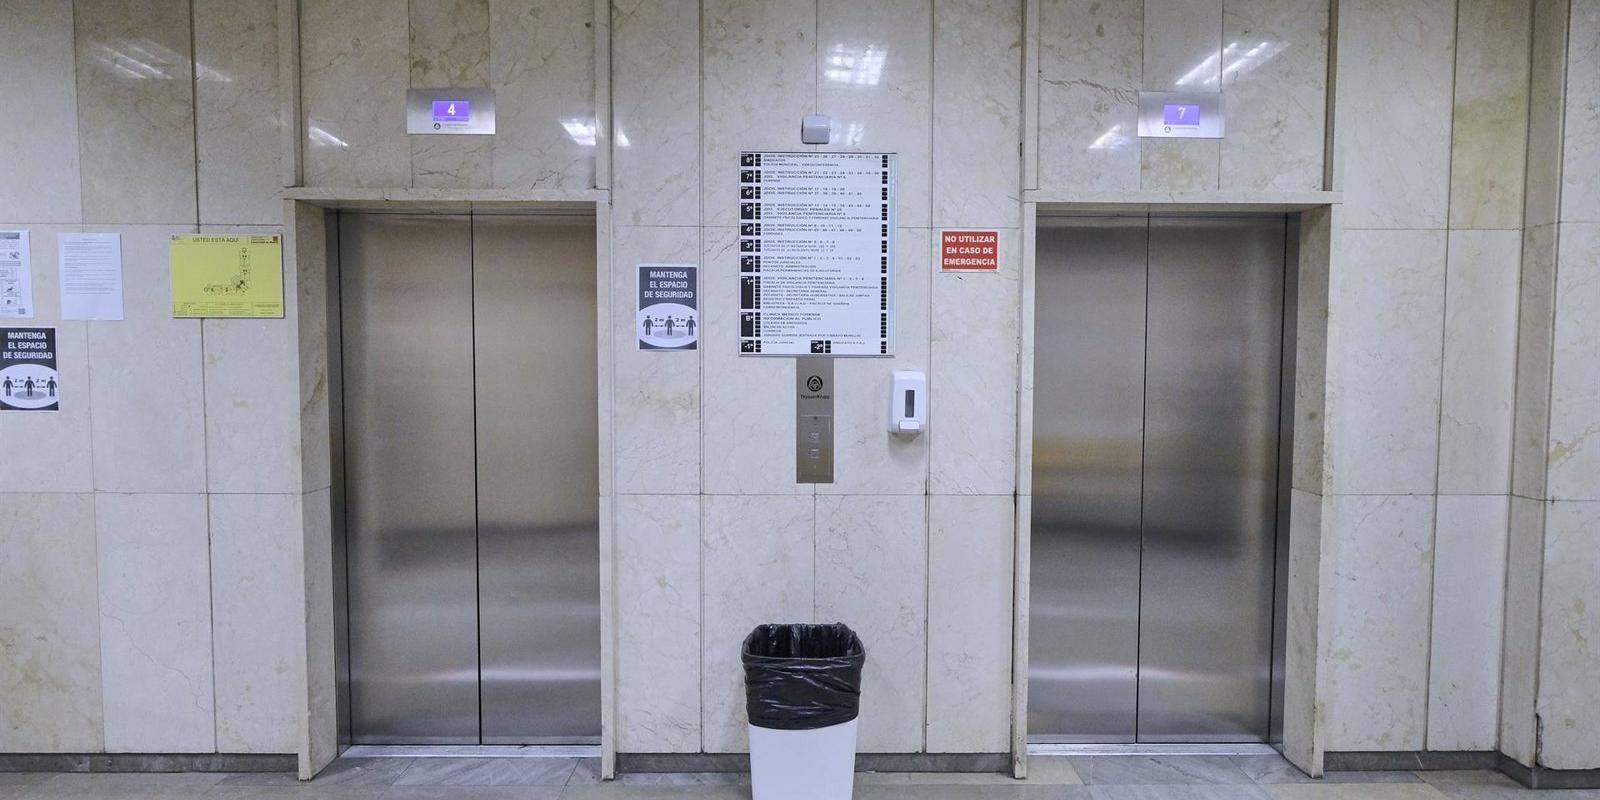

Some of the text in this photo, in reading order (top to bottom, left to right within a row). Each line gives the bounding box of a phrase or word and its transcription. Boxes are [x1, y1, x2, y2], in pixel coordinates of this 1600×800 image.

[447, 103, 456, 116] 4
[1177, 107, 1187, 119] 7
[946, 246, 993, 254] EN CASO DE
[649, 271, 688, 279] MANTENGA
[649, 281, 688, 289] EL ESPACIO
[644, 290, 693, 298] DE SEGURIDAD
[7, 332, 47, 340] MANTENGA
[8, 341, 48, 349] EL ESPACIO
[2, 351, 53, 359] DE SEGURIDAD
